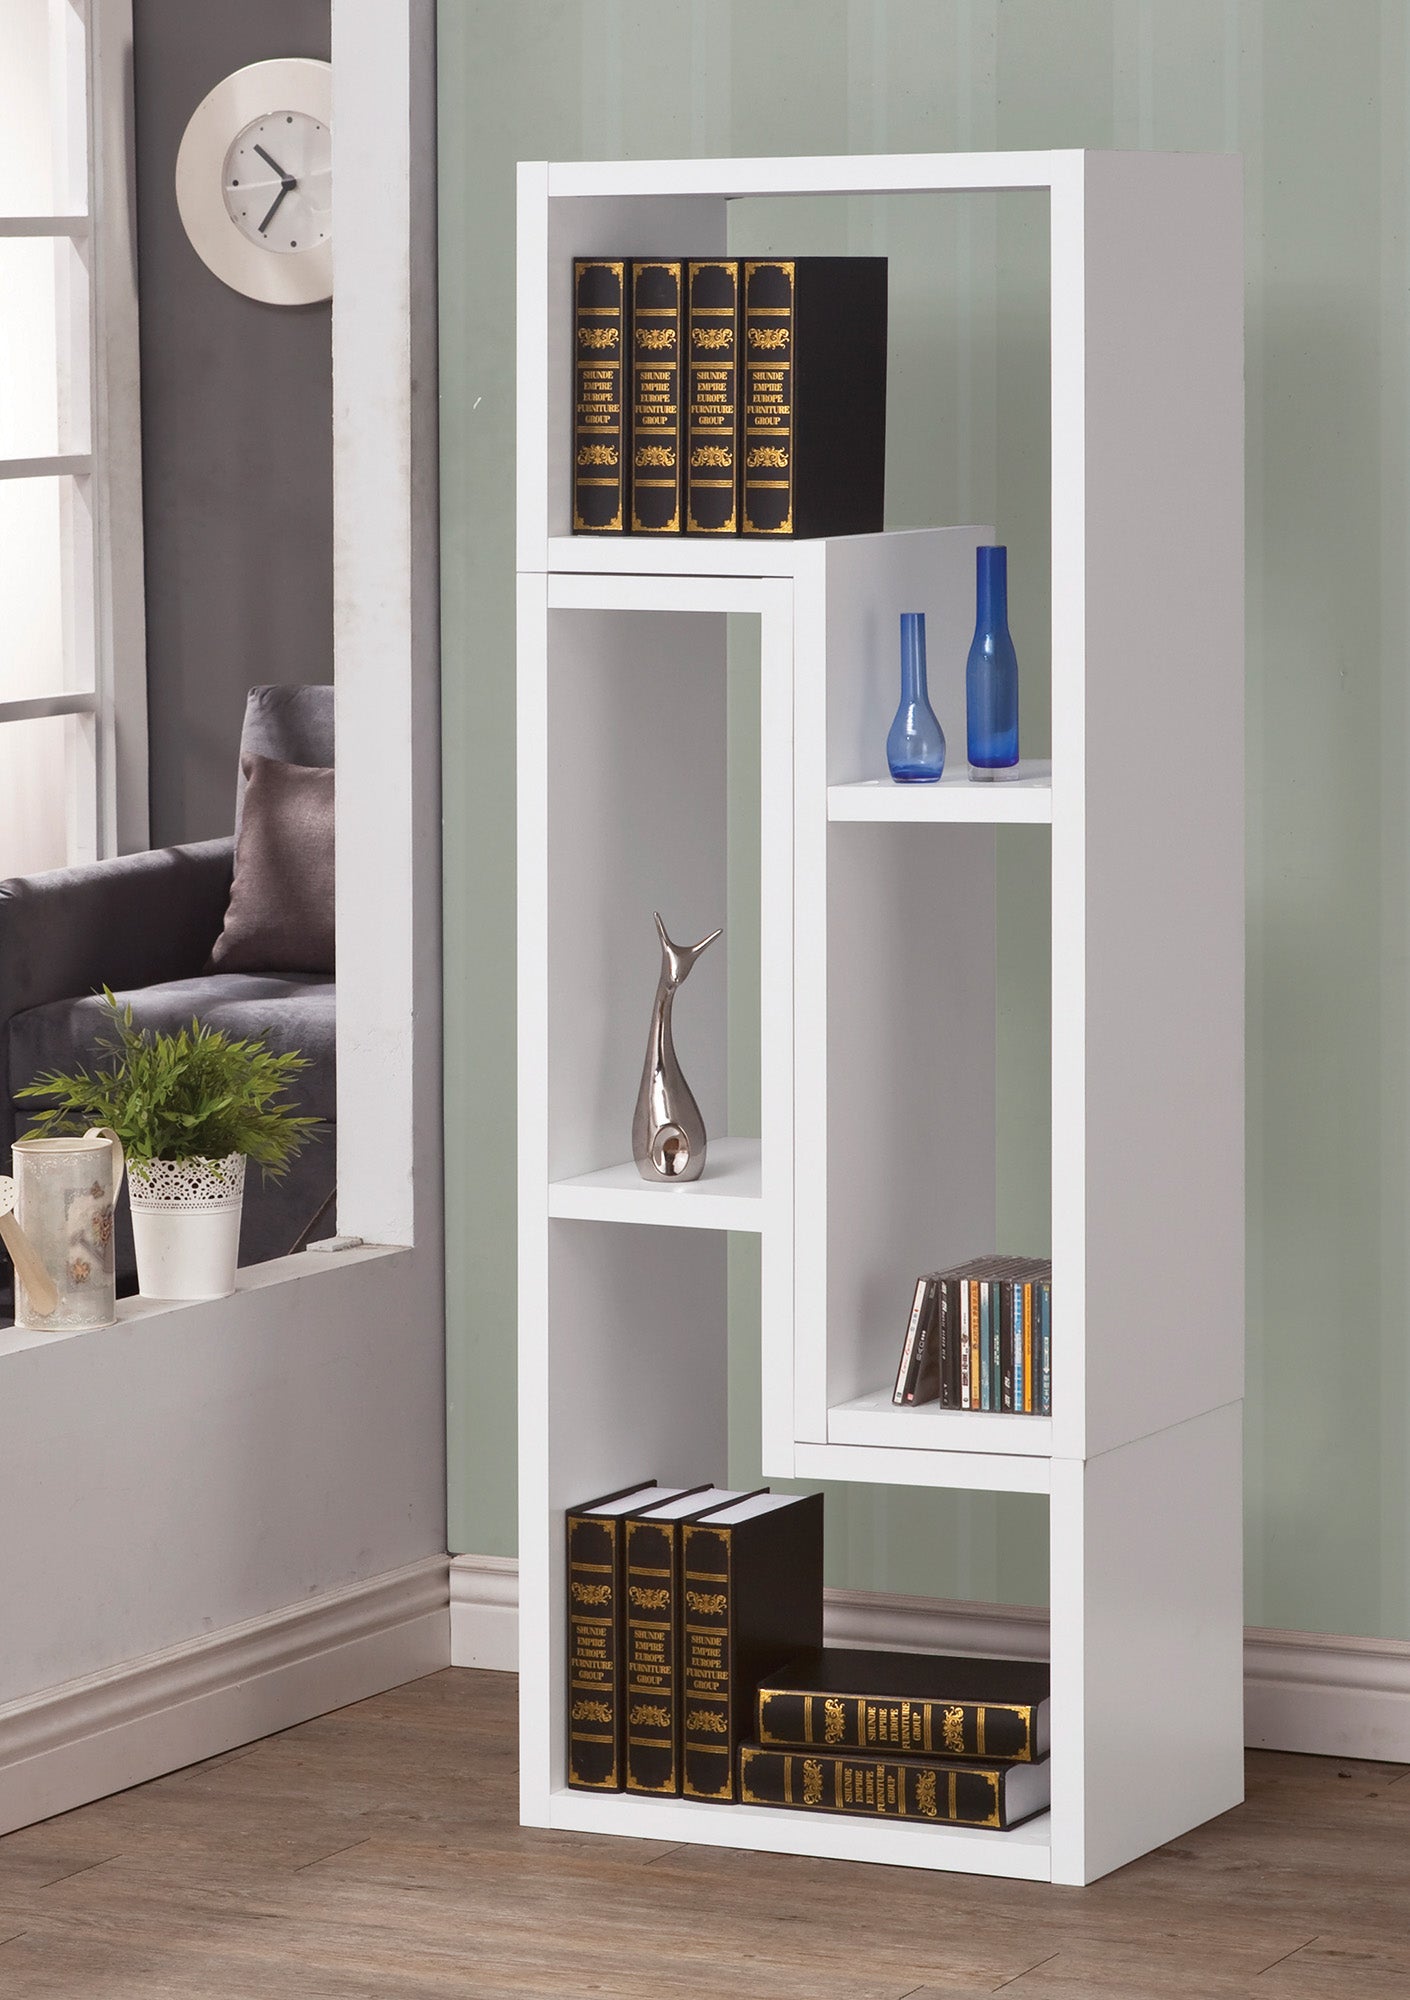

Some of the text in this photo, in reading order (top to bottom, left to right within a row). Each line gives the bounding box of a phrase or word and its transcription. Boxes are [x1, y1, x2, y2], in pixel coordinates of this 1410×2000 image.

[583, 371, 614, 380] SHUNDE
[640, 372, 670, 380] SHUNDE
[696, 372, 728, 380] SHUNDE
[752, 372, 784, 380] SHUNDE
[584, 382, 612, 390] EMPIRE
[641, 383, 670, 392] EMPIRE
[698, 383, 726, 392] EMPIRE
[754, 383, 782, 392] EMPIRE
[583, 393, 613, 402] EUROPE
[640, 394, 670, 402] EUROPE
[697, 394, 727, 402] EUROPE
[753, 394, 784, 402] EUROPE
[578, 404, 620, 412] FURNITURE
[636, 405, 676, 414] FURNITURE
[691, 405, 734, 414] FURNITURE
[747, 406, 790, 414] FURNITURE
[585, 415, 610, 424] GROUP
[642, 416, 668, 424] GROUP
[698, 416, 724, 425] GROUP
[754, 416, 780, 425] GROUP
[576, 1626, 606, 1636] SHUNDE
[634, 1630, 664, 1640] SHUNDE
[578, 1636, 606, 1648] EMPIRE
[692, 1635, 722, 1646] SHUNDE
[636, 1641, 664, 1652] EMPIRE
[577, 1648, 606, 1658] EUROPE
[635, 1652, 664, 1662] EUROPE
[692, 1646, 721, 1658] EMPIRE
[572, 1658, 614, 1670] FURNITURE
[692, 1657, 722, 1668] EUROPE
[630, 1662, 672, 1674] FURNITURE
[579, 1670, 604, 1680] GROUP
[686, 1668, 728, 1680] FURNITURE
[637, 1674, 662, 1685] GROUP
[694, 1680, 720, 1691] GROUP
[868, 1706, 876, 1740] SHUNDE
[878, 1708, 888, 1740] EMPIRE
[890, 1708, 898, 1742] EUROPE
[902, 1702, 910, 1749] FURNITURE
[844, 1768, 852, 1803] SHUNDE
[855, 1770, 864, 1802] EMPIRE
[866, 1770, 874, 1804] EUROPE
[876, 1764, 886, 1812] FURNITURE
[888, 1776, 896, 1804] GROUP
